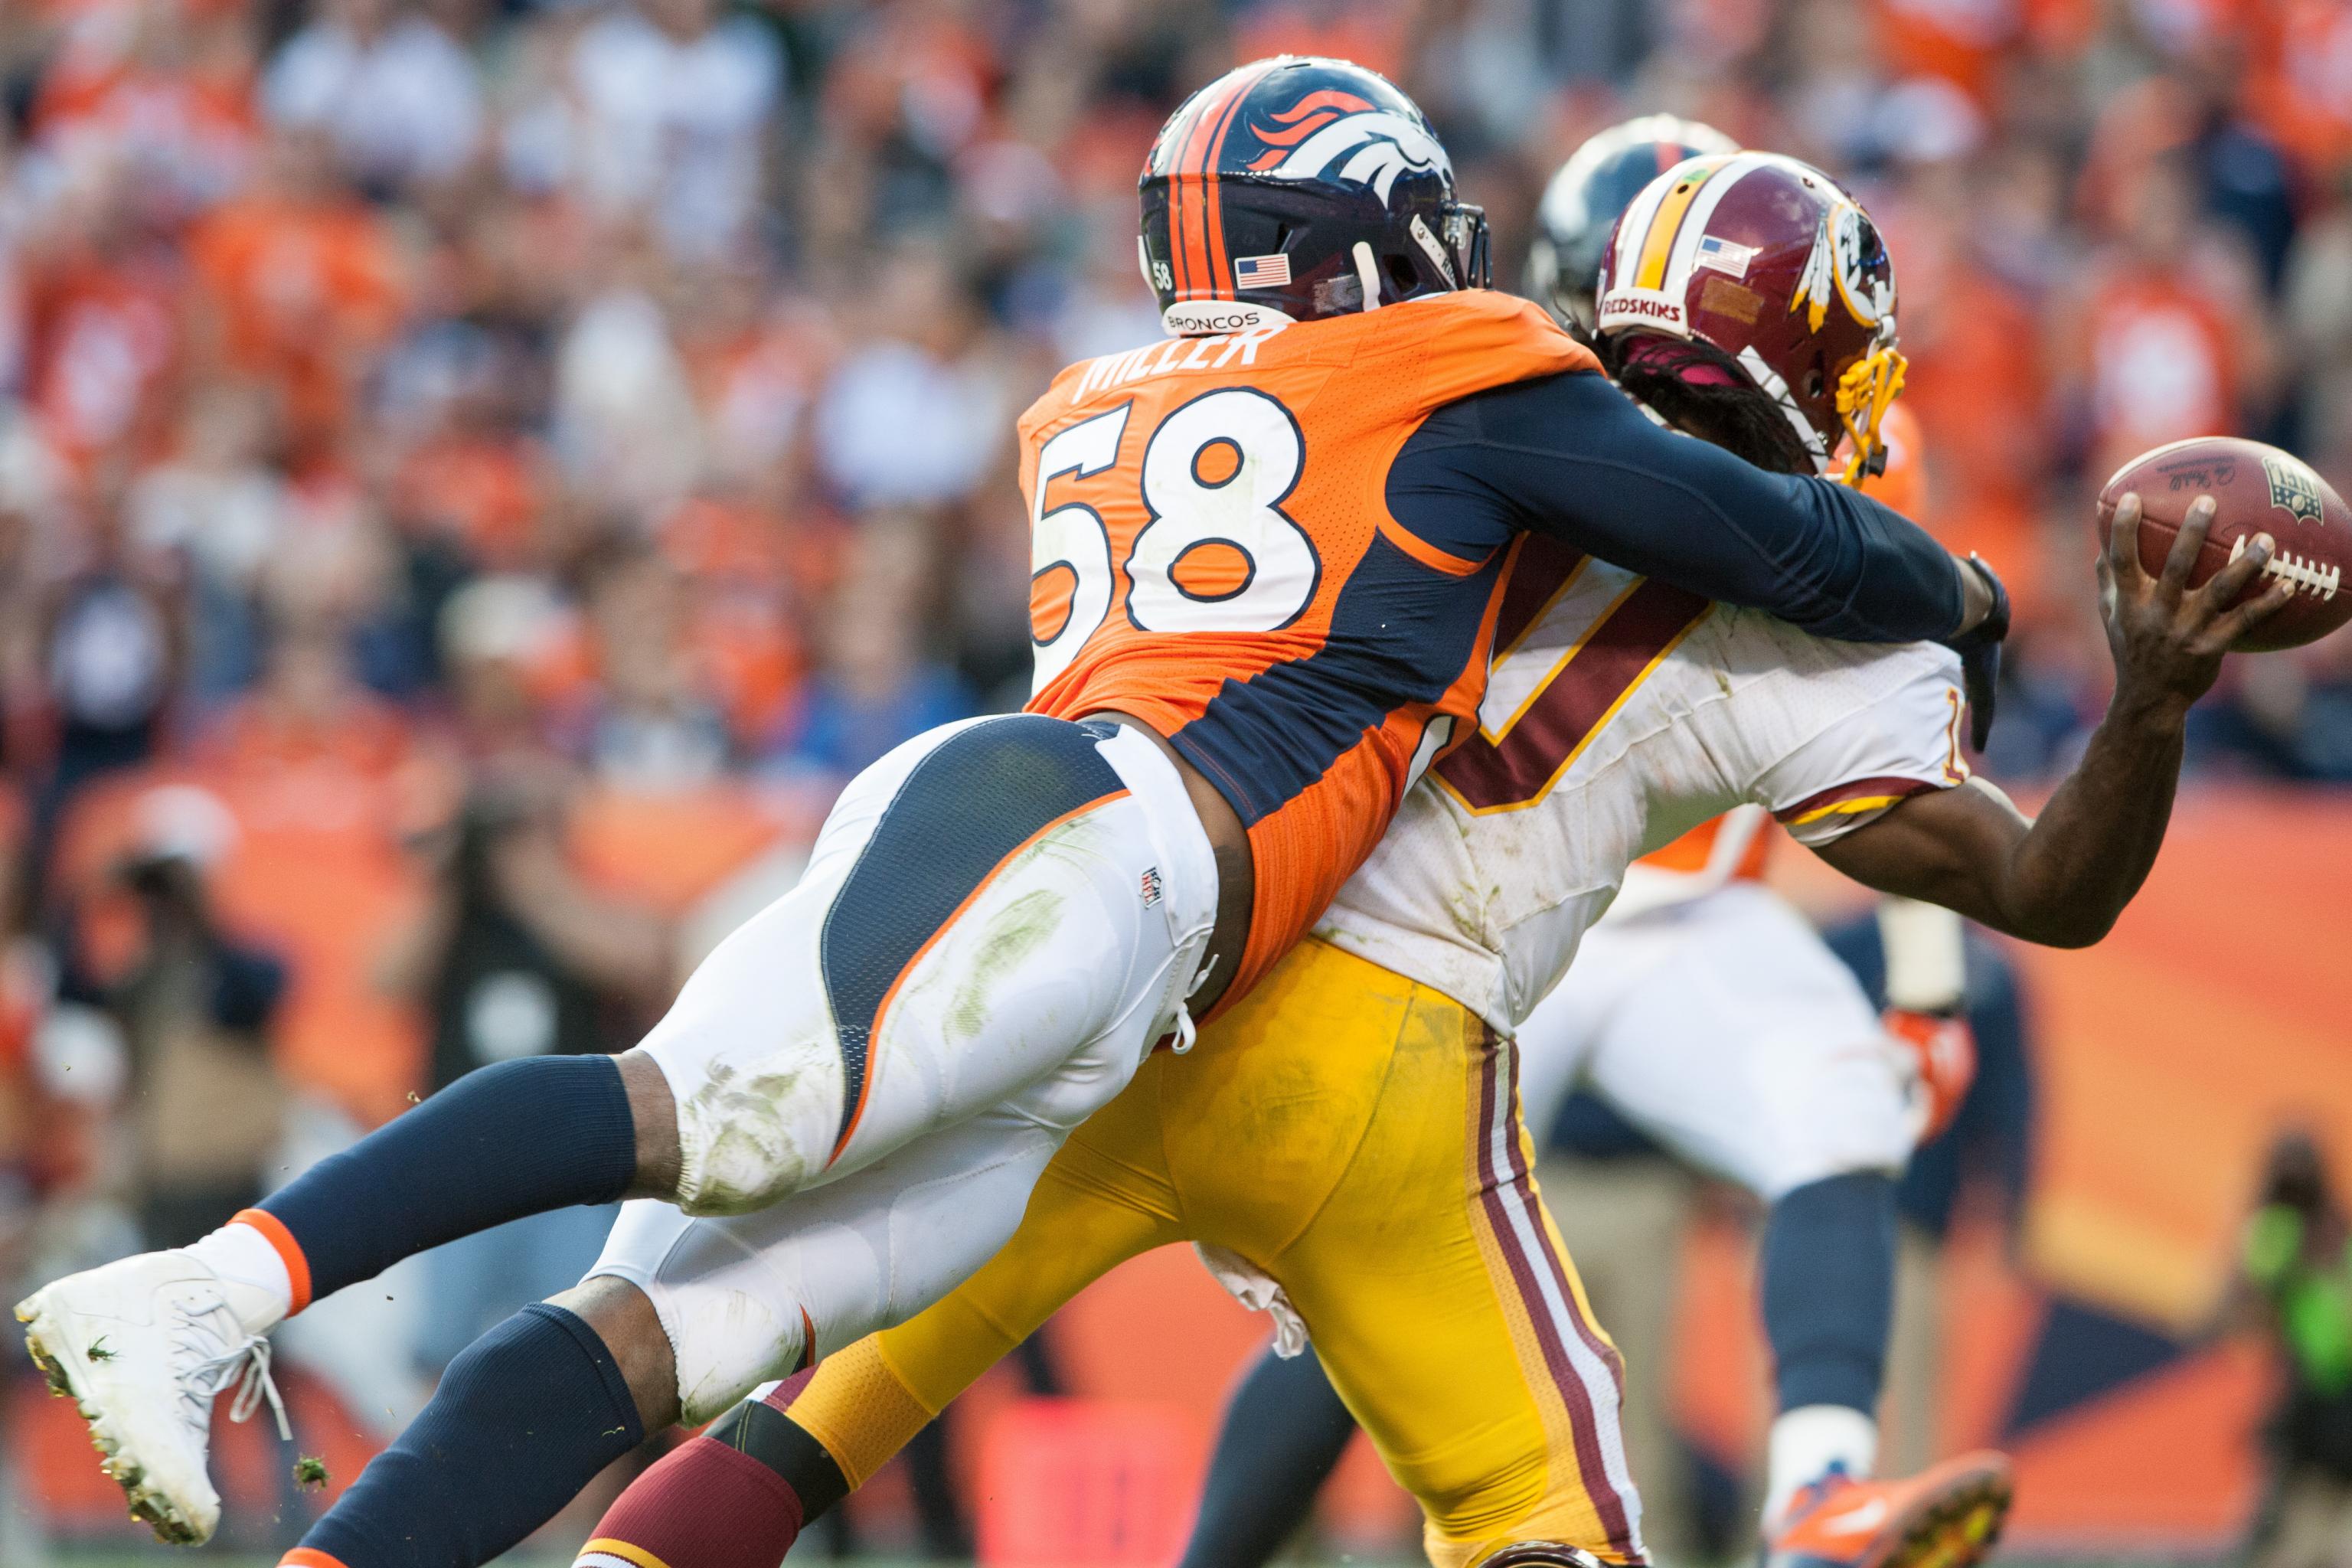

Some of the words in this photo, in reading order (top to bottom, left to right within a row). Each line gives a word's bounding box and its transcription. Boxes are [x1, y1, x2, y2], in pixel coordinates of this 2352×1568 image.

[1152, 263, 1173, 291] 58
[1168, 312, 1260, 331] BRONCOS
[1604, 298, 1680, 322] REDSKINS
[1072, 324, 1288, 405] MILLER
[1030, 386, 1322, 698] 58
